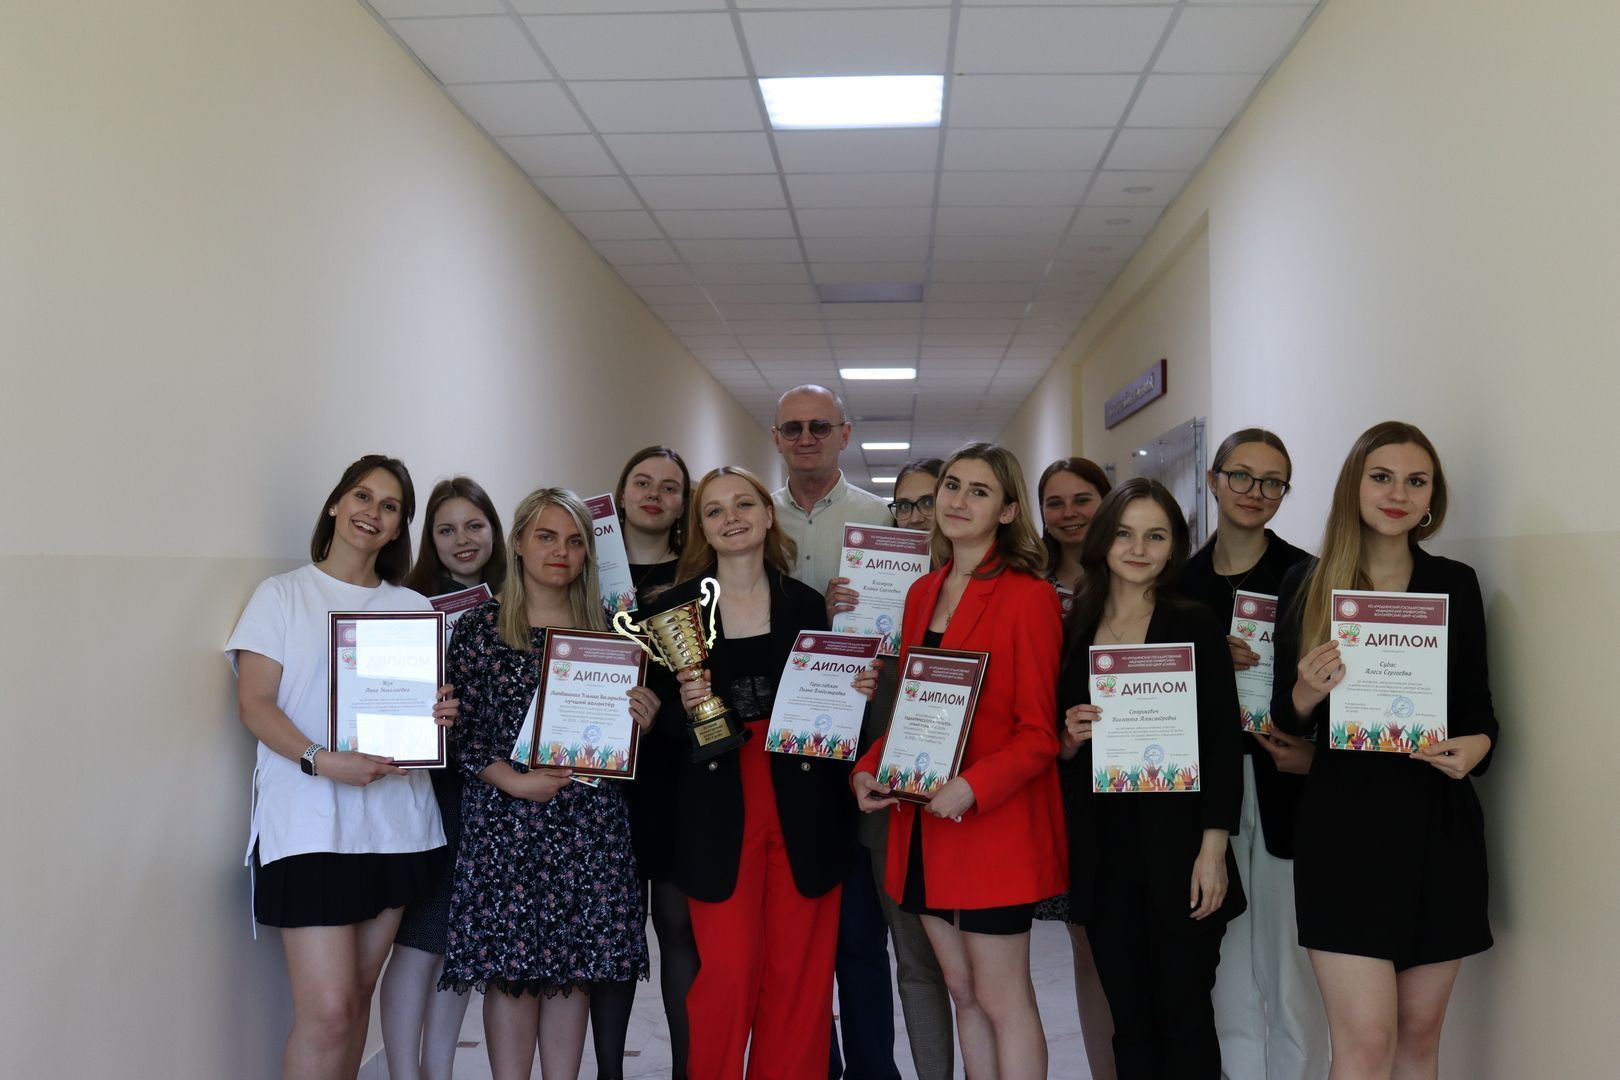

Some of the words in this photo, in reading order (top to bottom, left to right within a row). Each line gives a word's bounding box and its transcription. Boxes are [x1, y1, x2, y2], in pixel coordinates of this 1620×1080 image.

[866, 558, 922, 573] ДИПЛОМ
[1365, 633, 1438, 648] ДИПЛОМ
[811, 661, 866, 674] ДИПЛОМ
[573, 670, 632, 684] ДИПЛОМ
[1121, 681, 1188, 696] ДИПЛОМ
[919, 690, 965, 706] ДИПЛОМ
